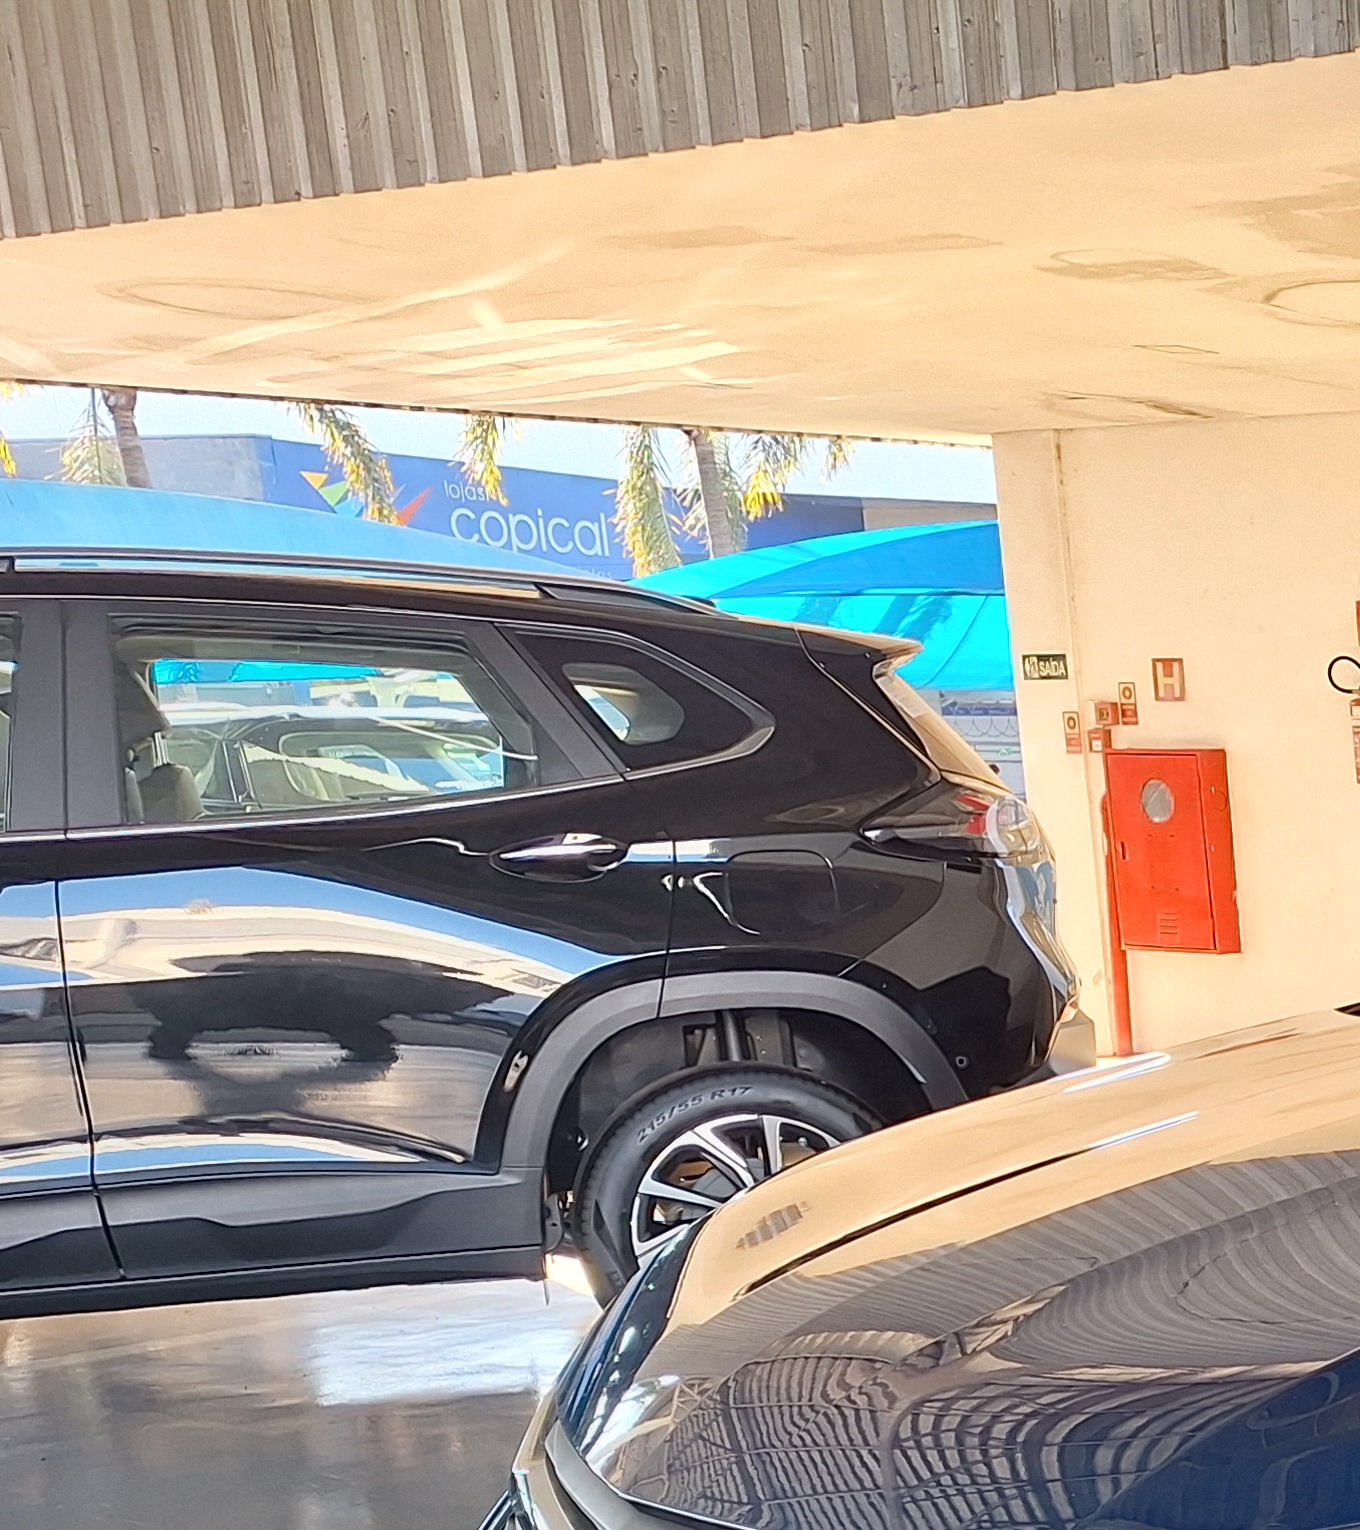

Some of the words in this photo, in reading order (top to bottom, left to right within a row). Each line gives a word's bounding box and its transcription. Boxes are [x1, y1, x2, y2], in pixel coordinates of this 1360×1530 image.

[451, 507, 610, 557] copical
[1039, 657, 1066, 677] SAÍDA
[1155, 661, 1181, 698] H
[637, 1094, 703, 1143] 215/55
[710, 1086, 752, 1100] R17
